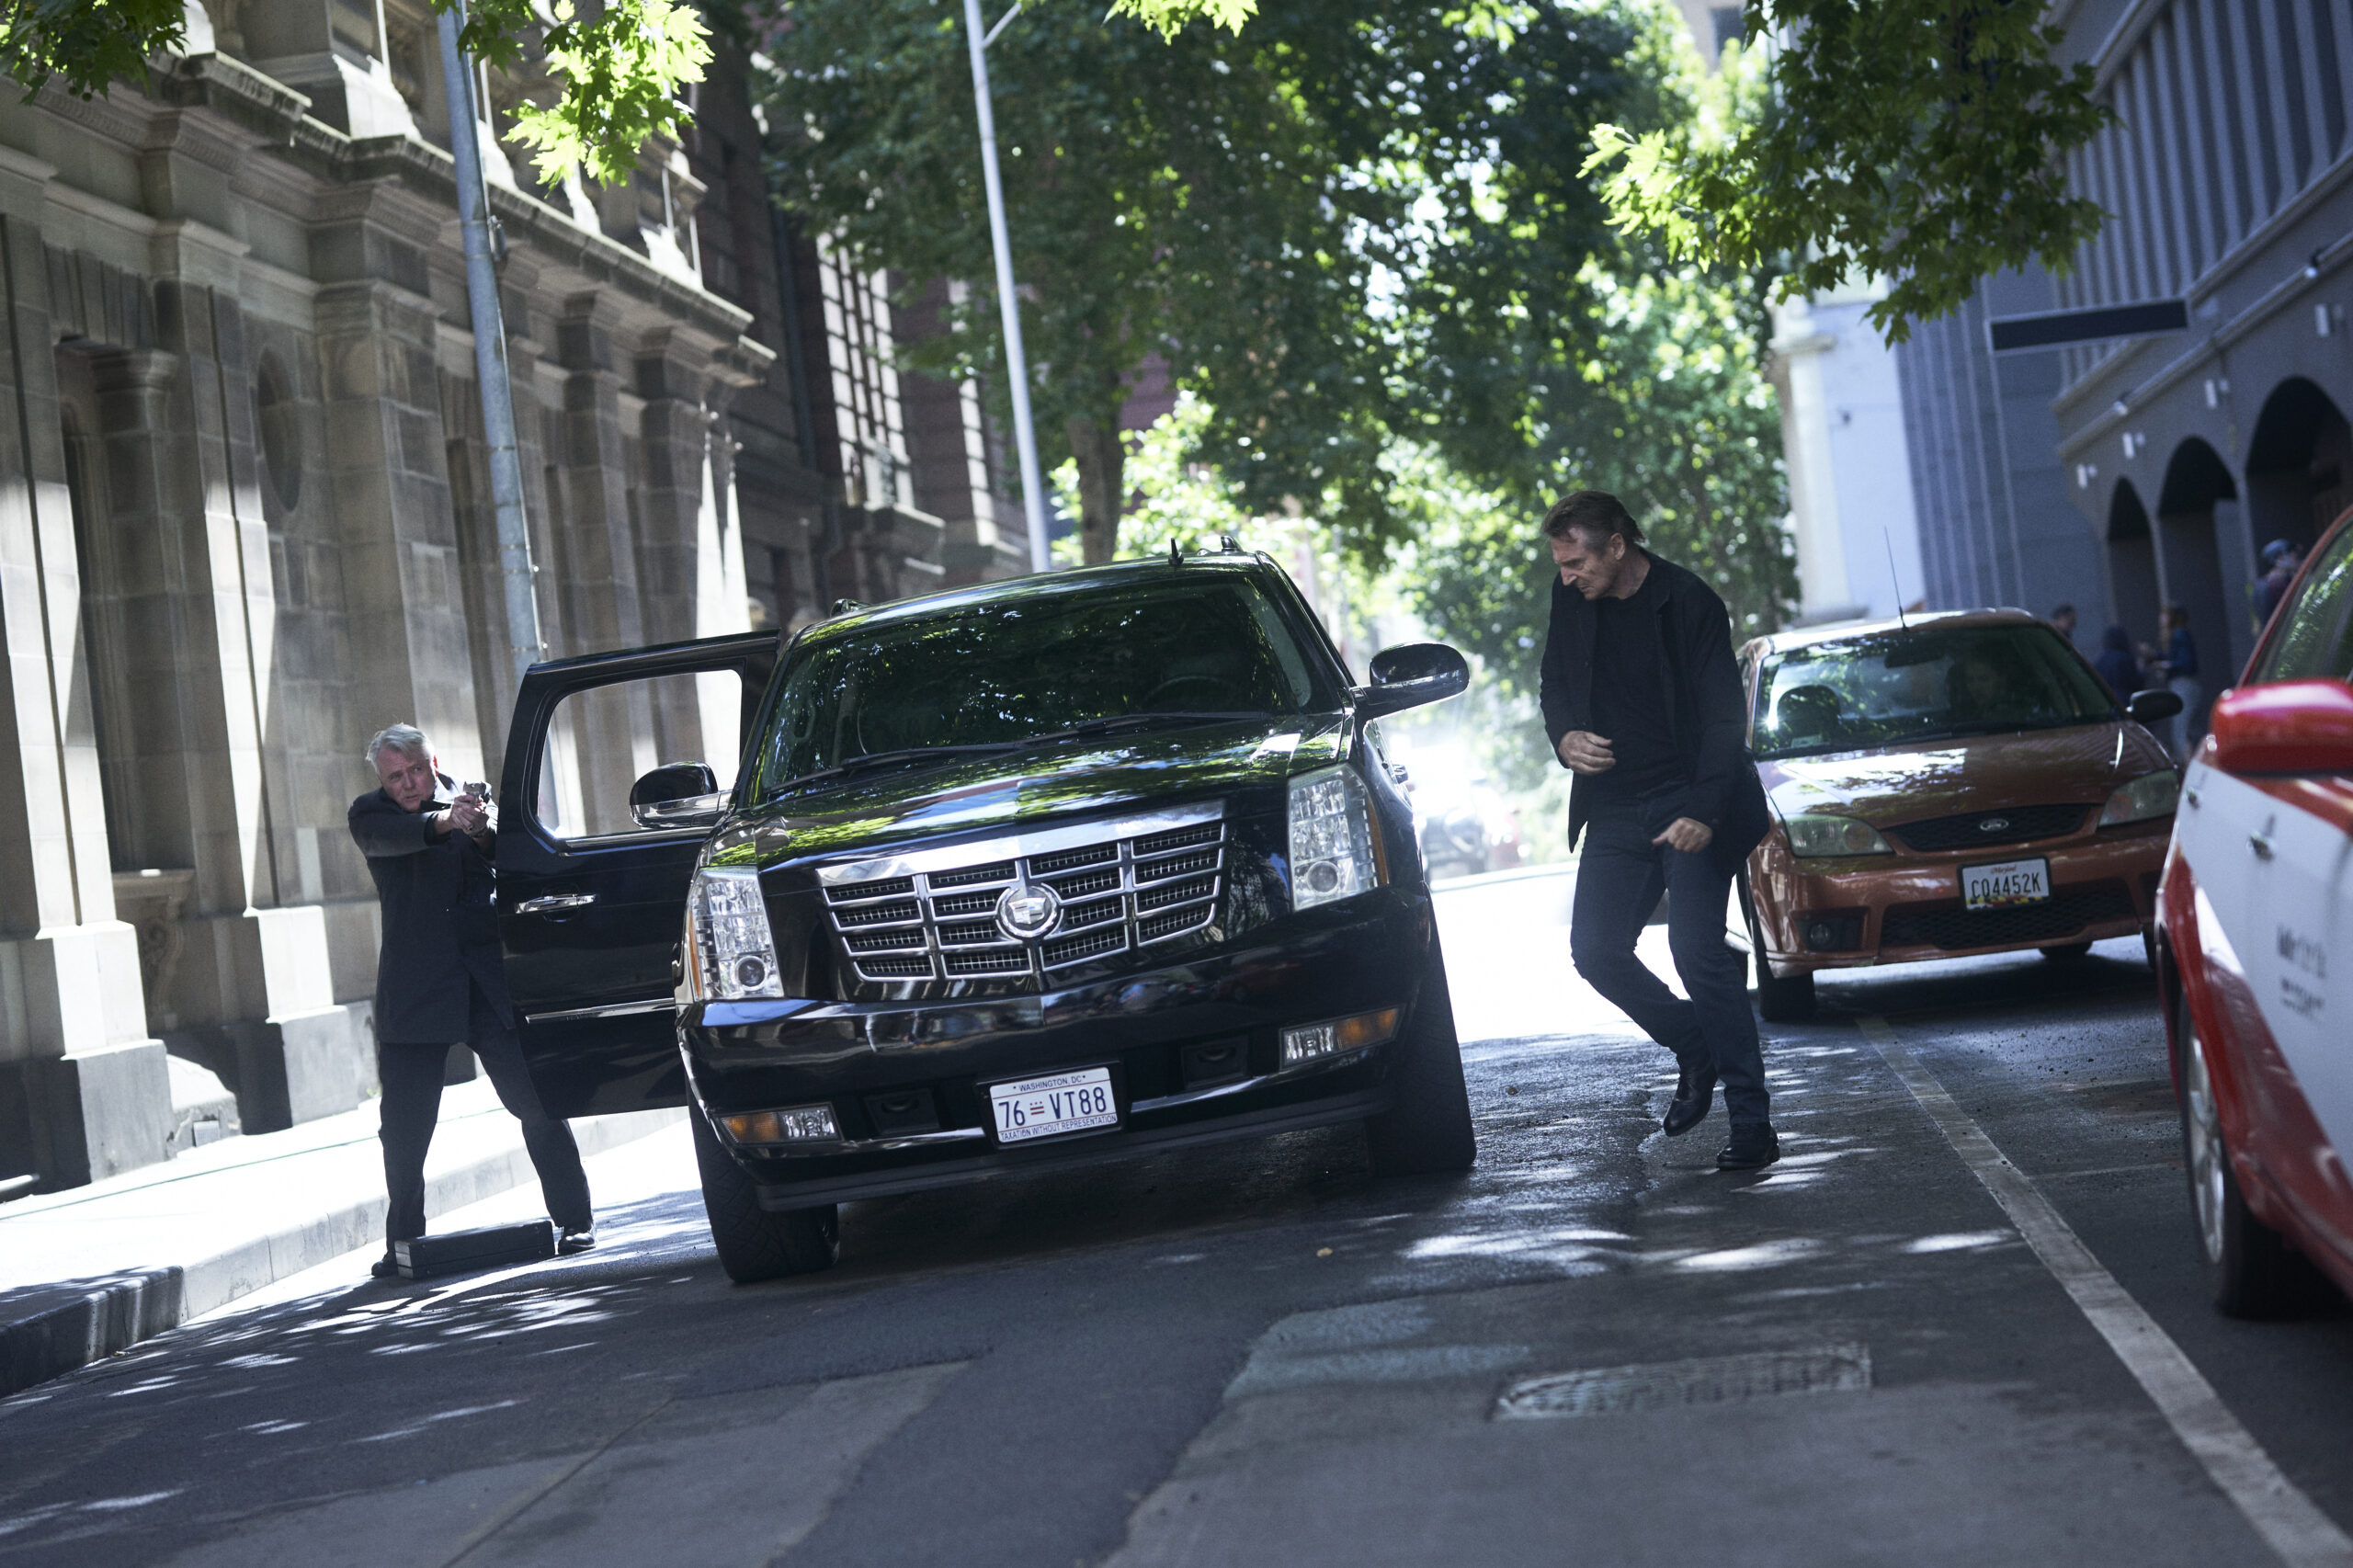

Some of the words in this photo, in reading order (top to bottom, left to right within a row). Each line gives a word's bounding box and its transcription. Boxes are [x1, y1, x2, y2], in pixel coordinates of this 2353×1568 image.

[1071, 1075, 1082, 1084] DC
[998, 1100, 1026, 1129] 76
[1049, 1086, 1107, 1119] VT88
[1001, 1130, 1031, 1141] TAXATION
[1032, 1123, 1061, 1134] WITHOUT
[1062, 1115, 1117, 1129] REPRESENTATION
